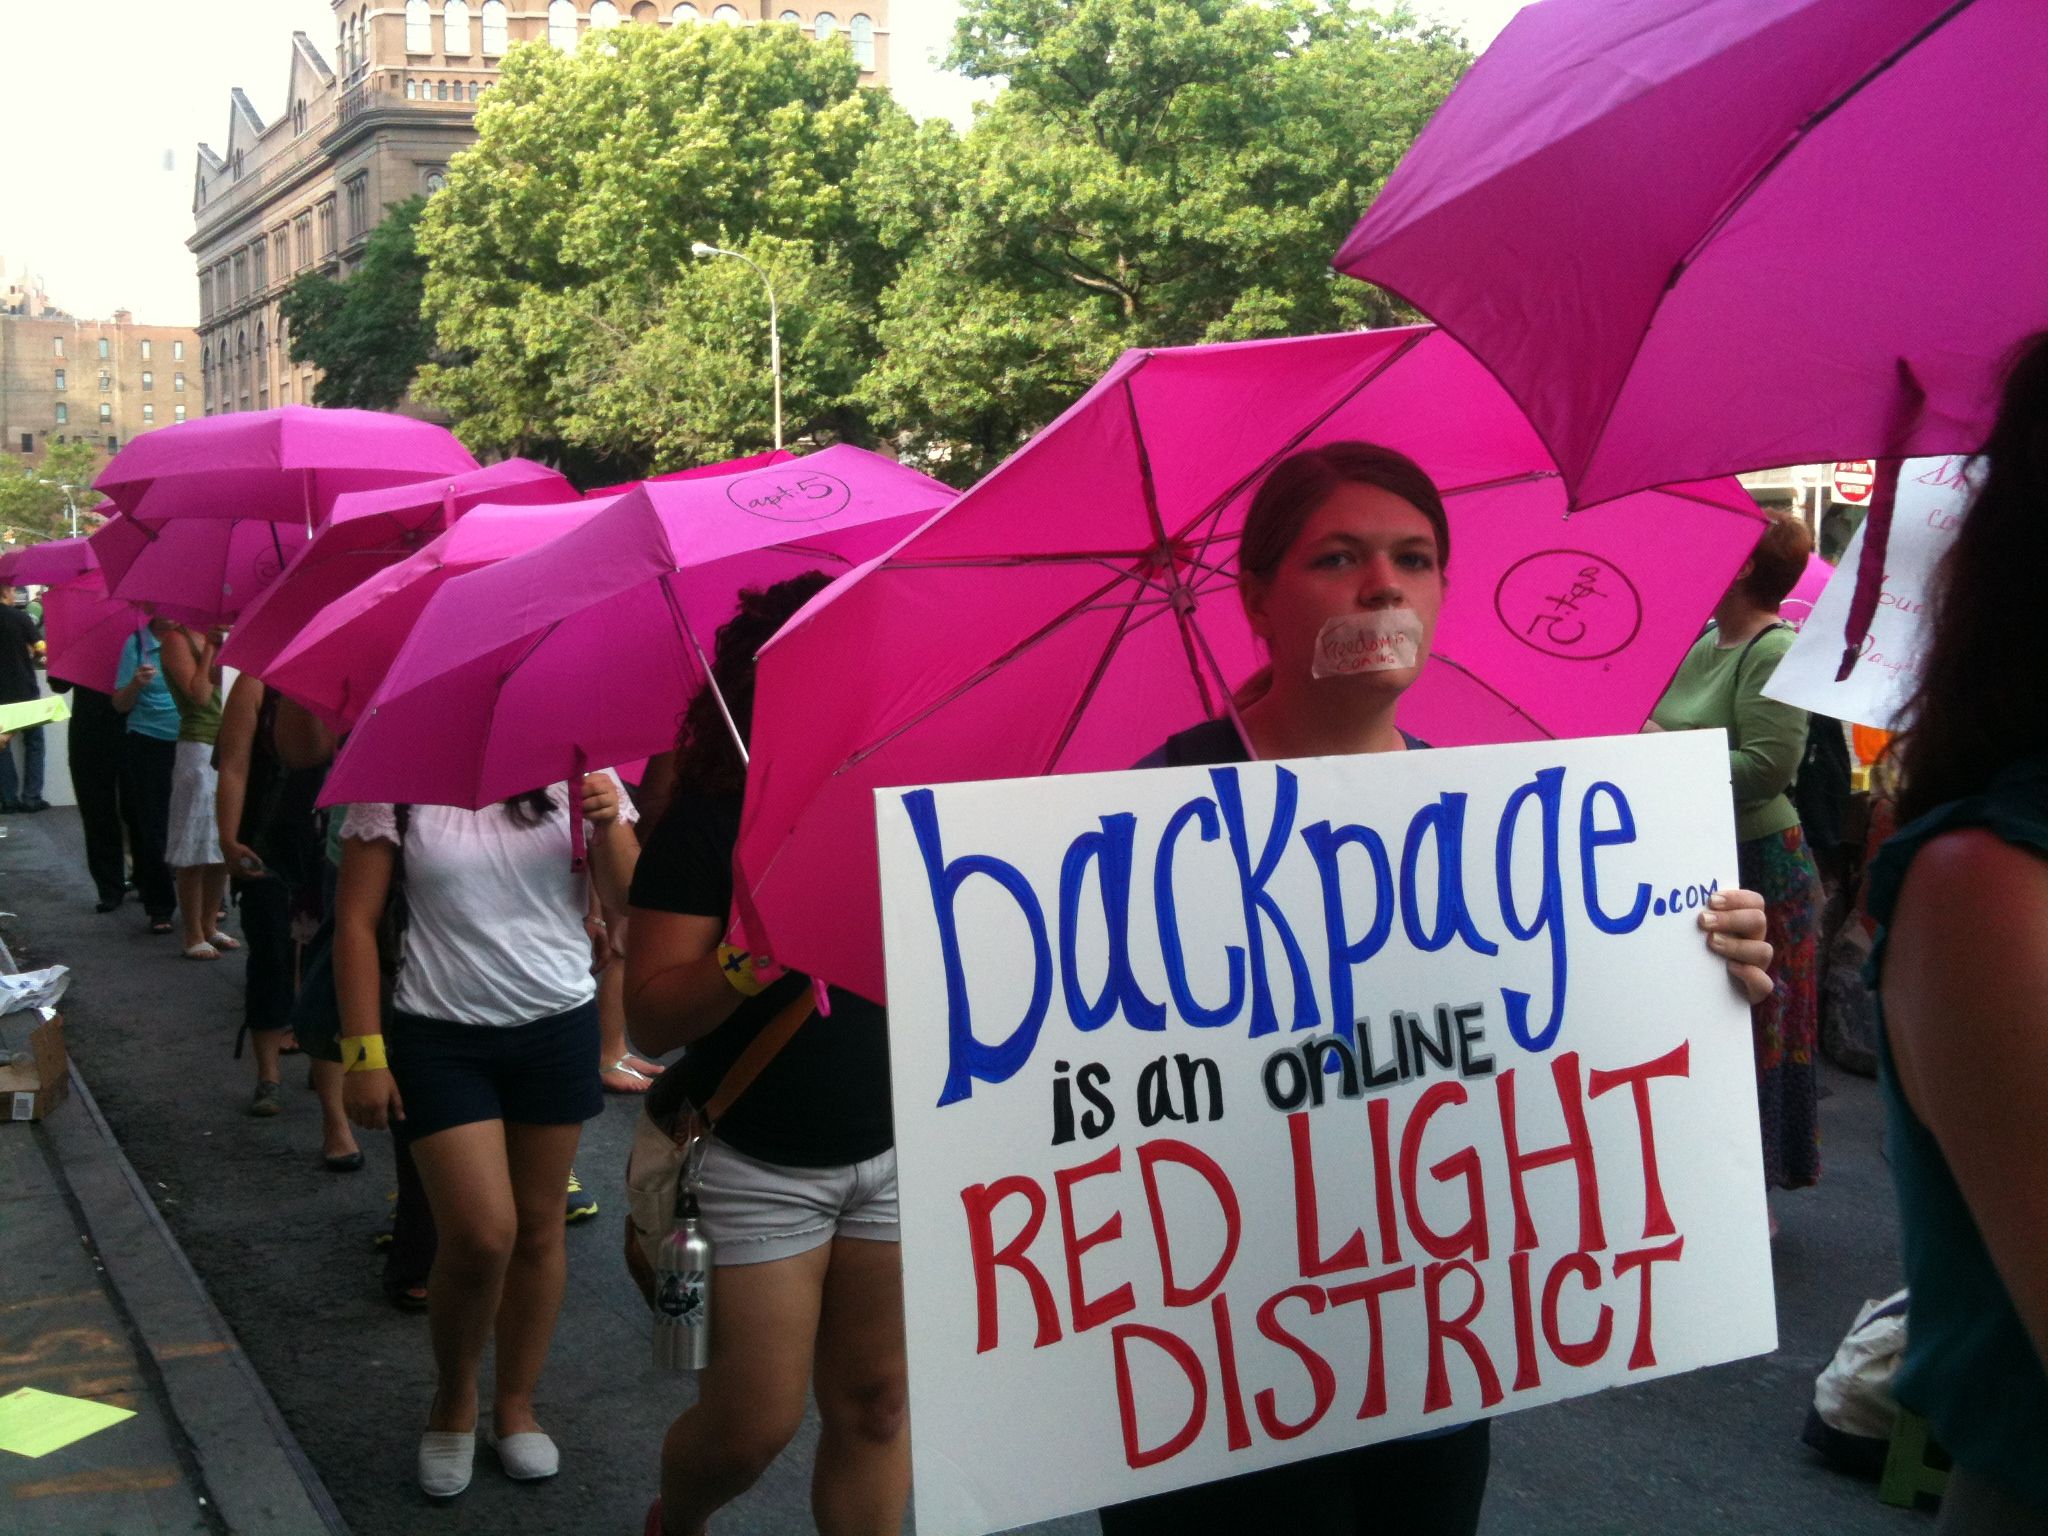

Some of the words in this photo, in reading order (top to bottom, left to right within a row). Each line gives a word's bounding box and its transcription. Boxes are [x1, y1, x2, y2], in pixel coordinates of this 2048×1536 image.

[960, 1138, 1241, 1355] RED
[1286, 1040, 1691, 1278] LIGHT
[1050, 1060, 1115, 1146] is
[1137, 1053, 1224, 1129] an
[1111, 1236, 1685, 1469] DISTRICT
